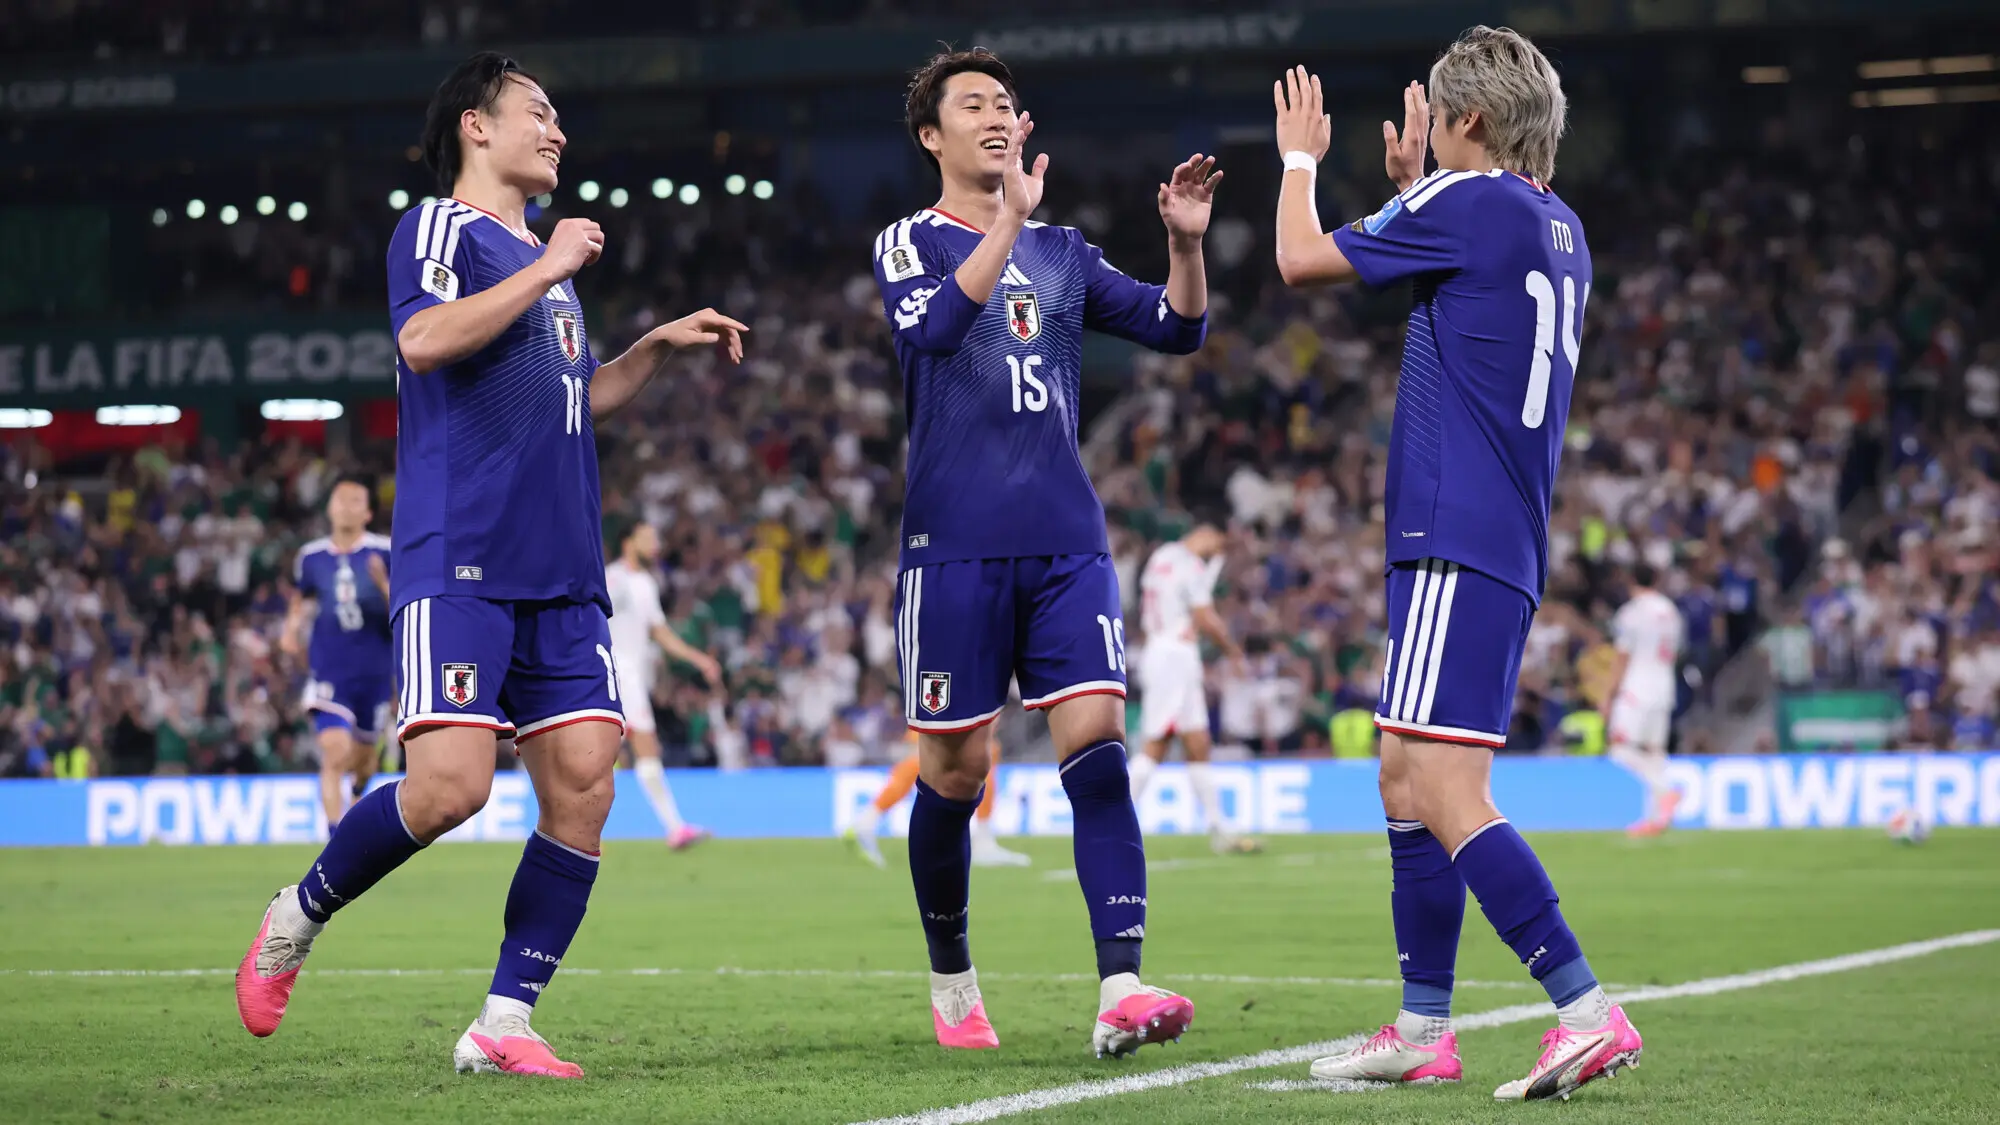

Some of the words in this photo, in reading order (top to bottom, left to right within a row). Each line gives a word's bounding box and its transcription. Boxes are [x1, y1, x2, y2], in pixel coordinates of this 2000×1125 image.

[1550, 218, 1573, 254] ITO
[35, 341, 104, 393] LA
[114, 335, 234, 390] FIFA
[246, 330, 396, 383] 202
[1006, 354, 1048, 413] 15
[596, 643, 619, 702] 1
[1106, 895, 1148, 908] JAPA
[520, 947, 561, 966] JAPA
